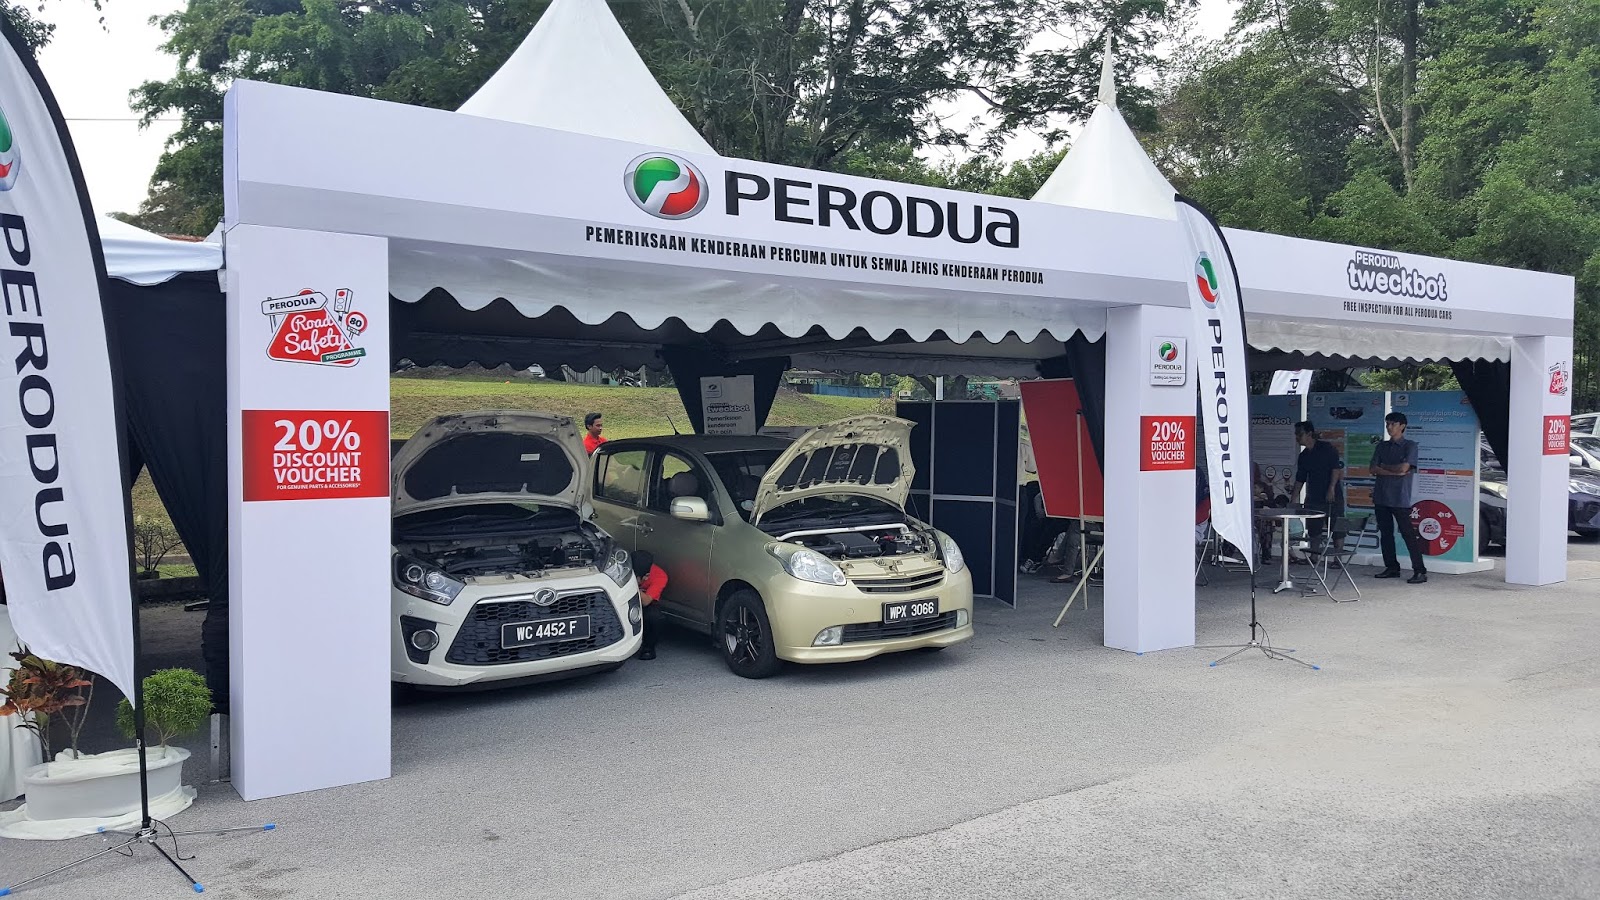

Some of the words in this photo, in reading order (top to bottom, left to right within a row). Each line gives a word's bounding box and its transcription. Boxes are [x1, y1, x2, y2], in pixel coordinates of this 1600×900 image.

[585, 225, 686, 251] PEMERIKSAAN
[691, 237, 766, 259] KENDERAAN
[770, 246, 827, 265] PERCUMA
[830, 252, 868, 269] UNTUK
[871, 256, 908, 273] SEMUA
[910, 260, 939, 275] JENIS
[942, 263, 999, 280] KENDERAAN
[1001, 269, 1044, 284] PERODUA
[1356, 252, 1400, 269] PERODUA
[1347, 261, 1447, 300] tweckbot
[269, 297, 317, 310] PERODUA
[1343, 301, 1357, 312] FREE
[1358, 302, 1392, 314] INSPECTION
[1393, 305, 1403, 316] FOR
[1404, 306, 1413, 316] ALL
[1414, 307, 1438, 319] PERODUA
[1439, 310, 1452, 320] CARS
[290, 314, 335, 332] Road
[349, 317, 362, 328] 80
[284, 328, 347, 356] Safety
[325, 349, 362, 361] PROGRAMME
[1251, 416, 1291, 425] weckbot
[1548, 419, 1566, 434] 20%
[274, 419, 361, 451] 20%
[1151, 421, 1185, 441] 20%
[1151, 441, 1185, 451] DISCOUNT
[273, 452, 362, 467] DISCOUNT
[1151, 451, 1185, 461] VOUCHER
[273, 467, 362, 484] VOUCHER
[889, 605, 907, 620] WPX
[911, 602, 934, 615] 3066
[516, 626, 533, 641] WC
[535, 621, 566, 639] 4452
[569, 620, 577, 634] F
